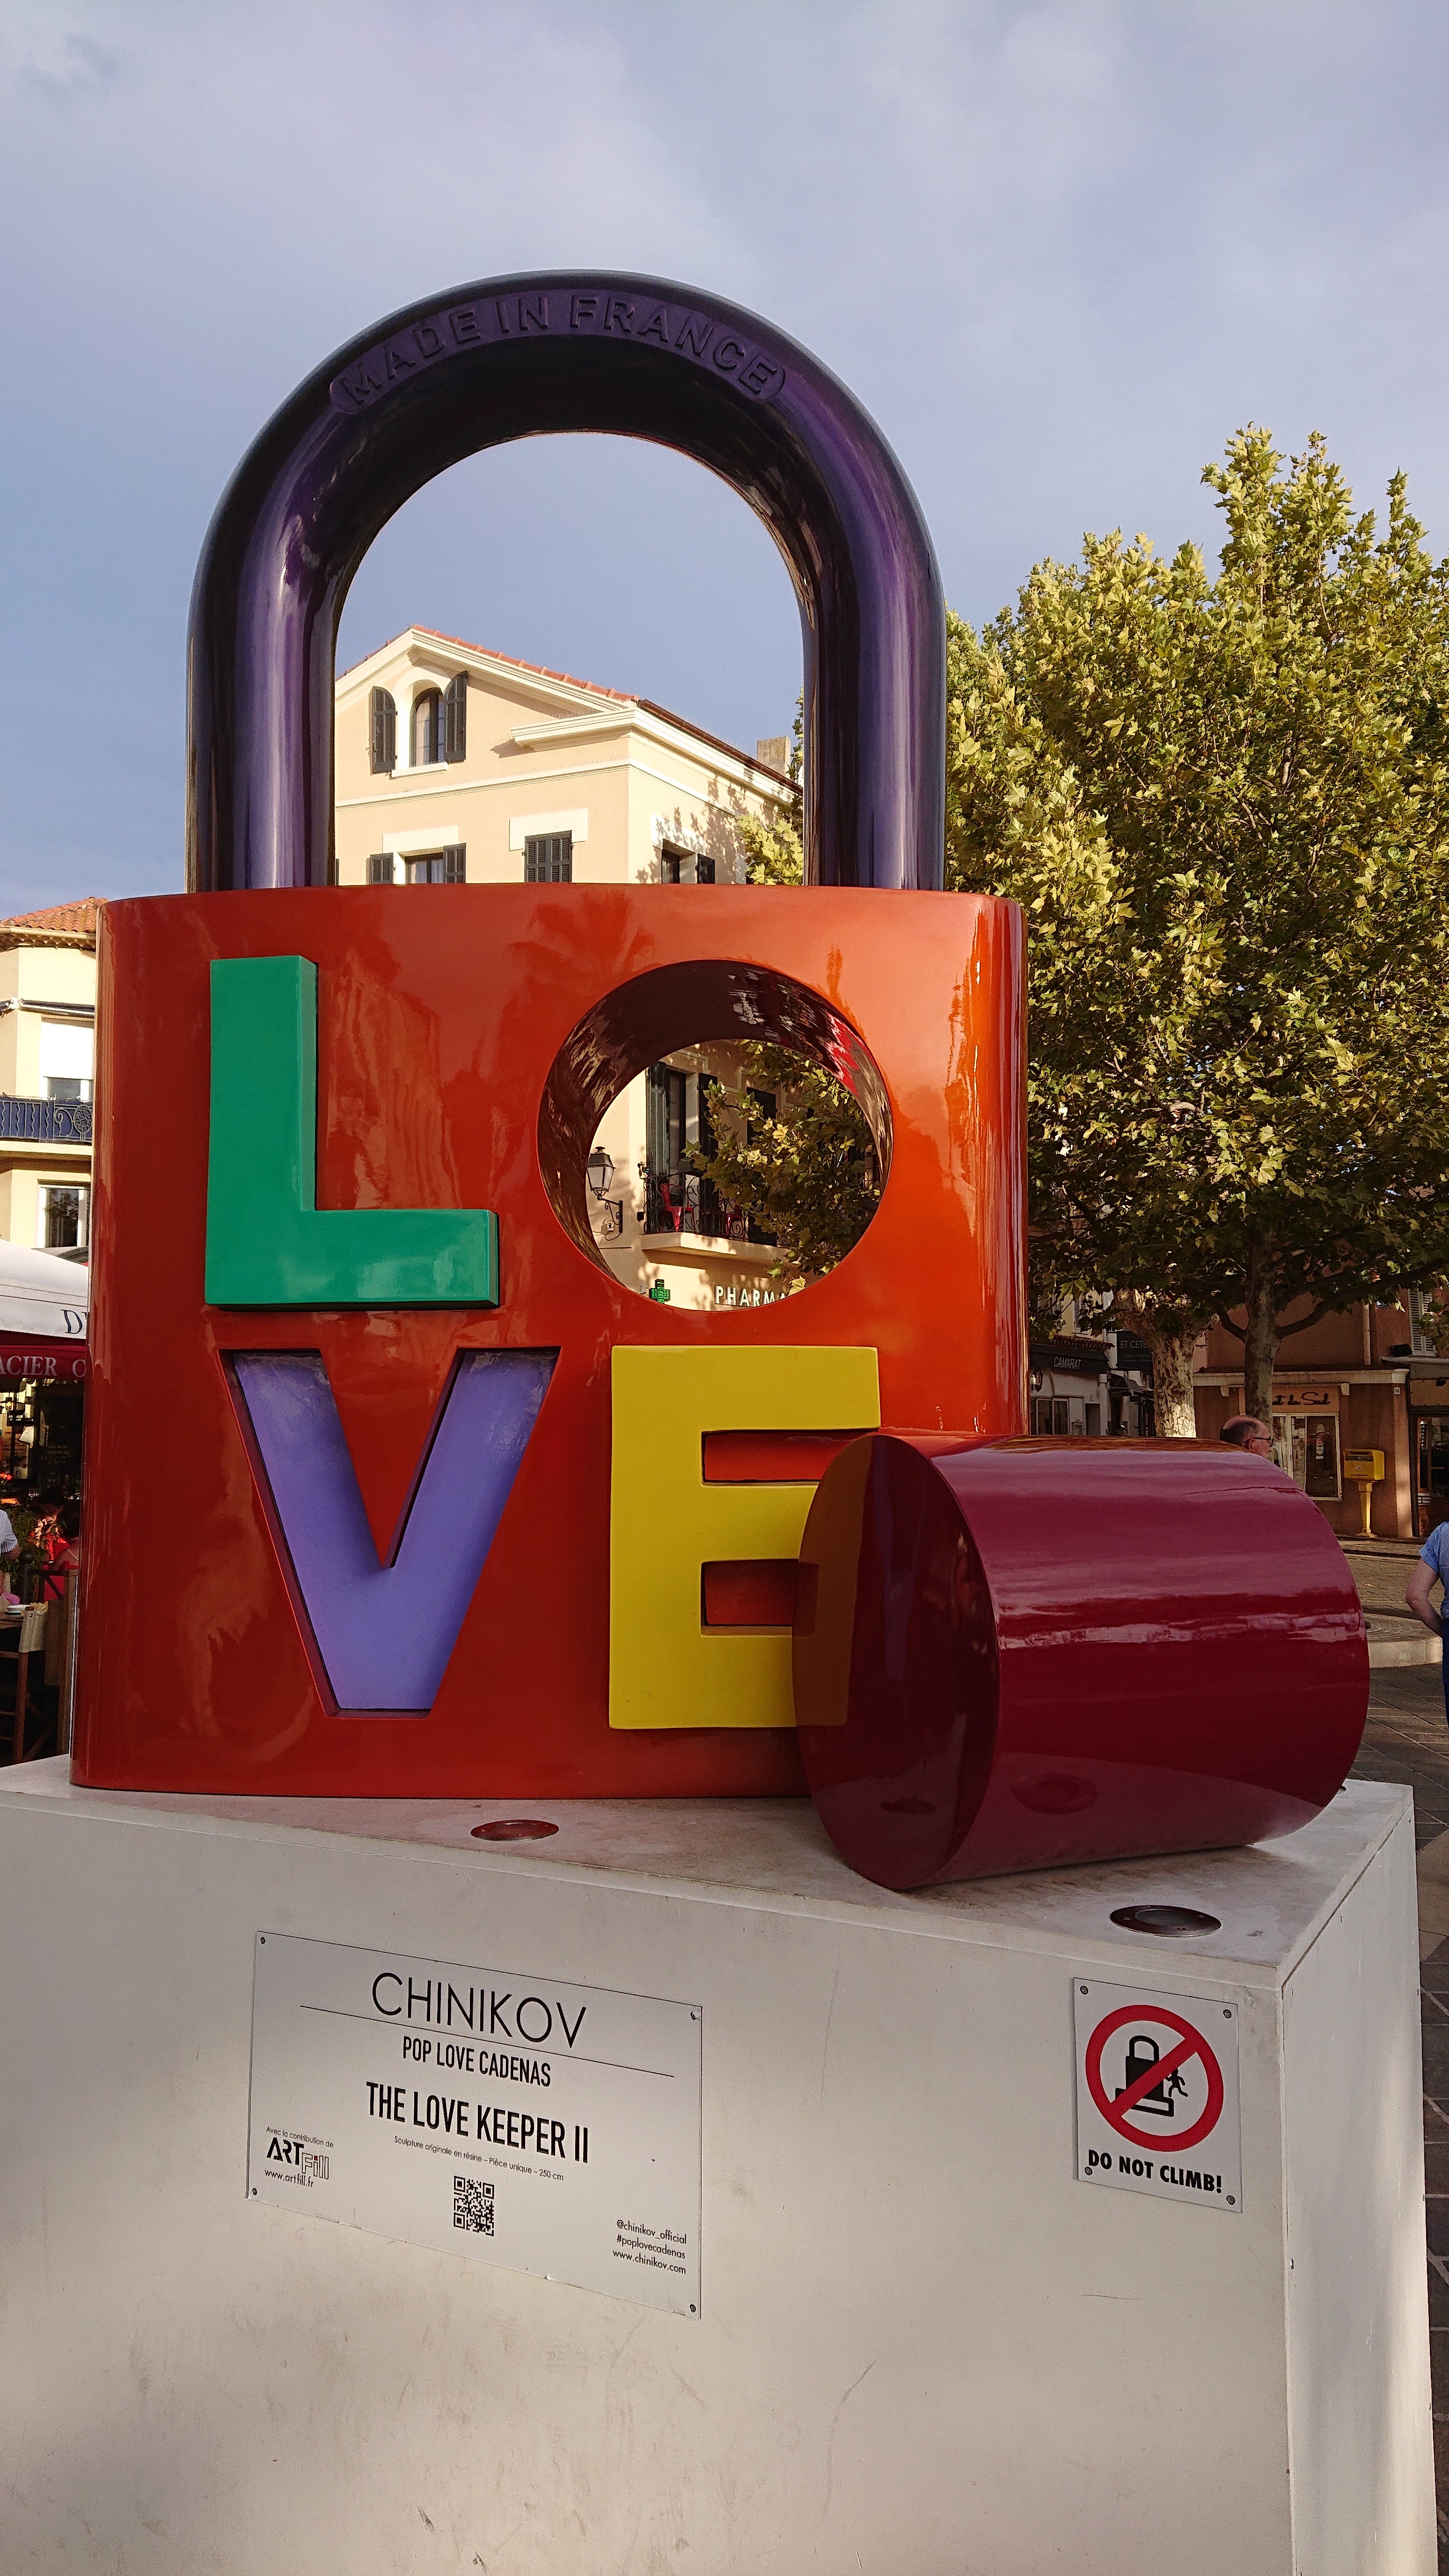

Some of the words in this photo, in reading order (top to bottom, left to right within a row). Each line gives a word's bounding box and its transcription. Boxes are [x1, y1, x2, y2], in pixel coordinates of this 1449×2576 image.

[341, 310, 481, 406] MADE
[497, 297, 549, 333] IN
[569, 294, 780, 396] FRANCE
[1120, 1340, 1128, 1348] ET
[1054, 1356, 1082, 1370] CAMARAT
[1302, 1391, 1331, 1405] Sud
[373, 1972, 587, 2049] CHINIKOV
[403, 2035, 432, 2063] POP
[437, 2042, 475, 2072] LOVE
[479, 2051, 551, 2087] CADENAS
[366, 2081, 406, 2123] THE
[413, 2091, 469, 2137] LOVE
[477, 2105, 566, 2159] KEEPER
[575, 2125, 588, 2164] II
[266, 2126, 281, 2136] Avec
[289, 2133, 324, 2146] contribution
[394, 2136, 424, 2149] Sculpture
[425, 2143, 452, 2155] originale
[463, 2151, 482, 2163] résine
[489, 2157, 508, 2168] Pièce
[509, 2163, 532, 2174] unique
[539, 2169, 551, 2178] 250
[553, 2173, 564, 2181] cm
[264, 2169, 314, 2188] www.artfill.fr
[1088, 2150, 1112, 2169] DO
[1119, 2156, 1154, 2179] NOT
[1160, 2165, 1222, 2194] CLIMB!
[616, 2219, 687, 2245] @chinikov_official
[616, 2234, 686, 2259] #poplovecadenas
[612, 2250, 686, 2274] www.chinikov.com
